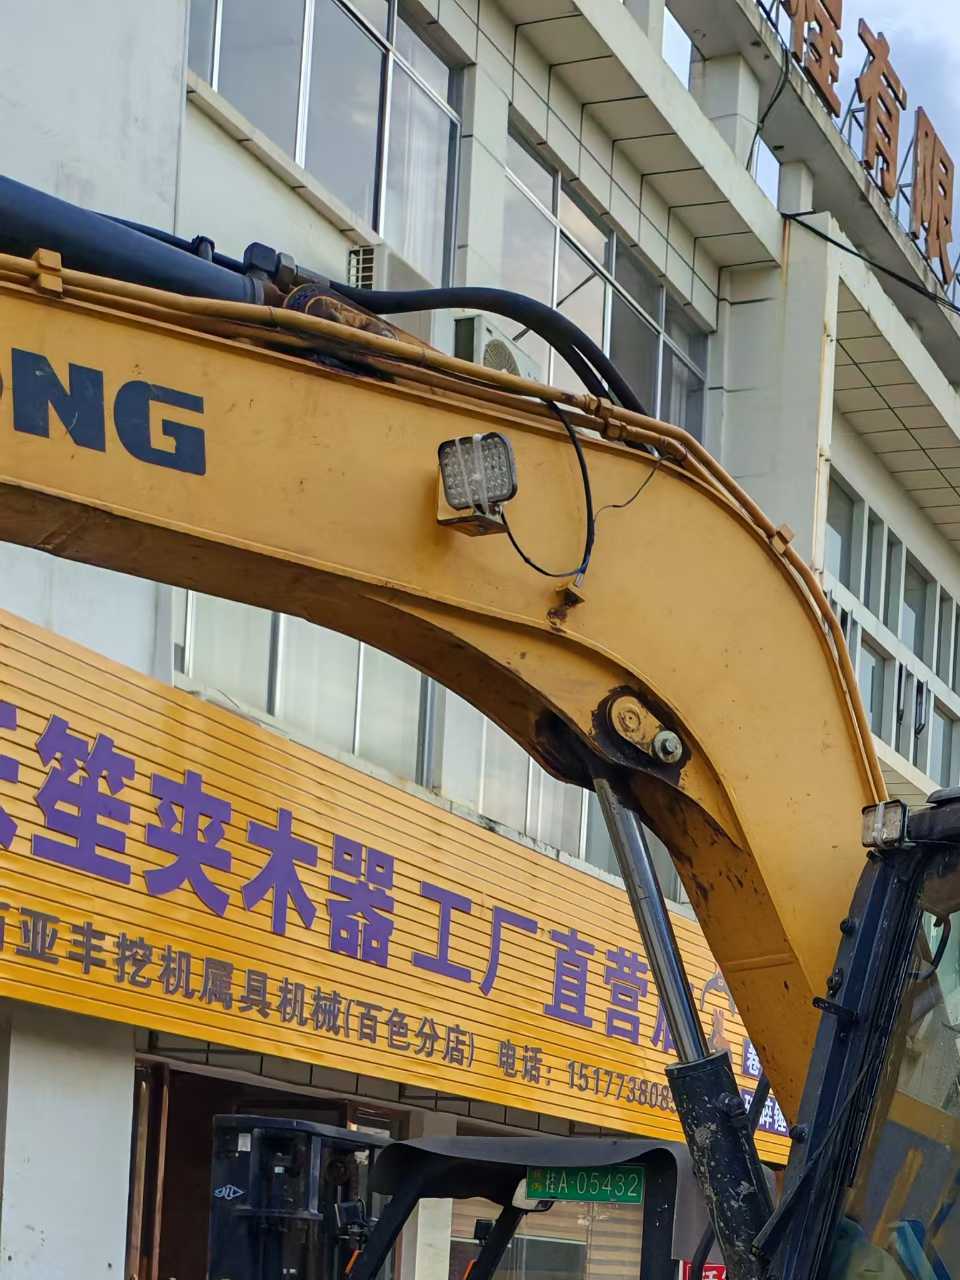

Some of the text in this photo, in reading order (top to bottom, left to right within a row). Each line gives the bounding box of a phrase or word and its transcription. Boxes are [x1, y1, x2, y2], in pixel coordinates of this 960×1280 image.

[0, 347, 207, 476] NG
[0, 700, 695, 1053] 笙夹木器工厂直营
[0, 902, 475, 1067] 亚丰挖机属具机械(百色分店)
[567, 1060, 677, 1112] 151773808
